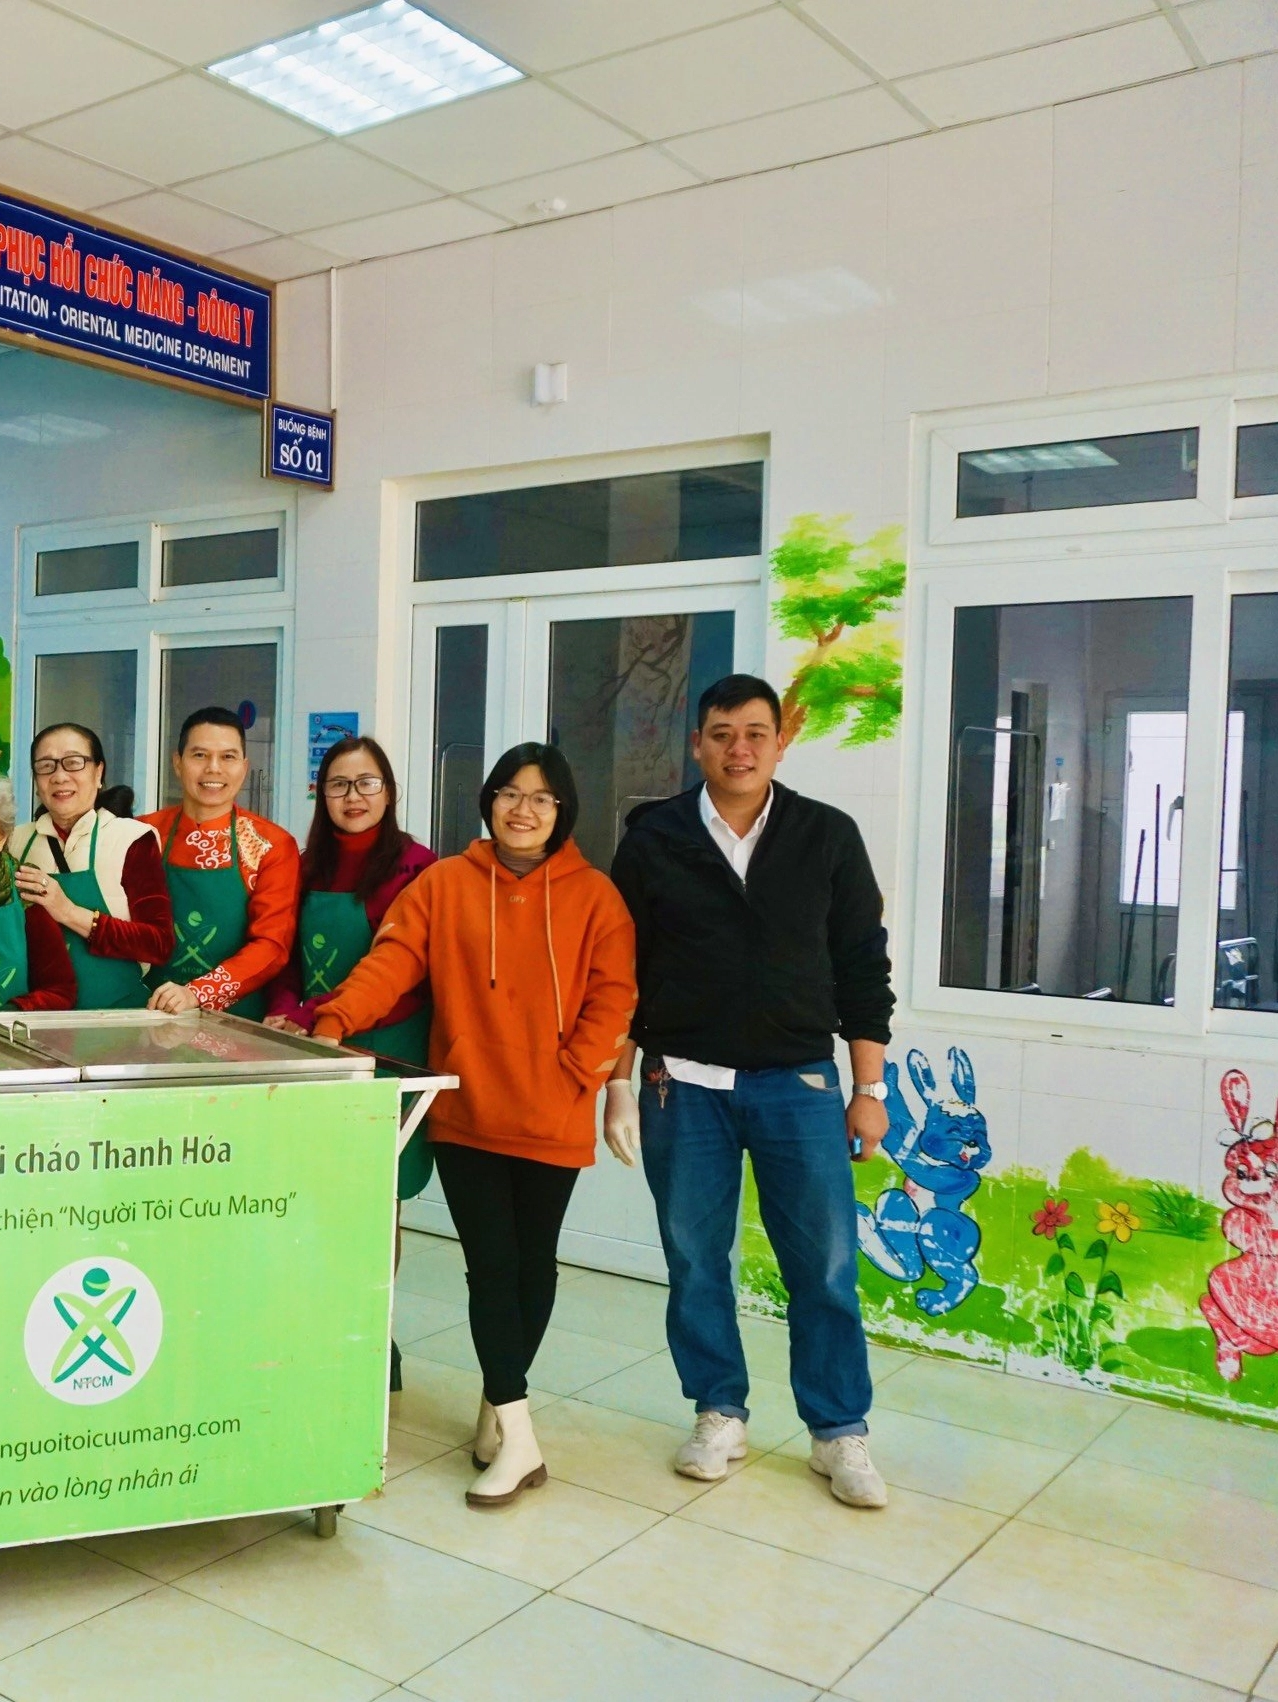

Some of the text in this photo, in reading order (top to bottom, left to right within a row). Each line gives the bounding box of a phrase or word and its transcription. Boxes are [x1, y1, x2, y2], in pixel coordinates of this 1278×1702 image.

[49, 232, 81, 294] HỒI
[84, 253, 134, 309] CHỨC
[136, 266, 185, 326] NĂNG
[187, 305, 195, 317] -
[197, 287, 241, 345] ĐÔNG
[243, 307, 255, 348] Y
[60, 304, 121, 341] ORIENTAL
[124, 323, 182, 359] MEDICINE
[185, 341, 251, 379] DEPARMENT
[307, 424, 327, 440] BỆNH
[280, 437, 323, 473] SỐ 01
[14, 1143, 80, 1173] cháo
[89, 1137, 172, 1170] Thanh
[182, 1135, 232, 1165] Hóa
[142, 1199, 172, 1221] Tôi
[179, 1197, 221, 1219] Cưu
[72, 1375, 114, 1390] NTCM
[19, 1481, 59, 1503] vào
[64, 1477, 113, 1500] lòng
[118, 1467, 173, 1492] nhân
[179, 1463, 200, 1485] ái
